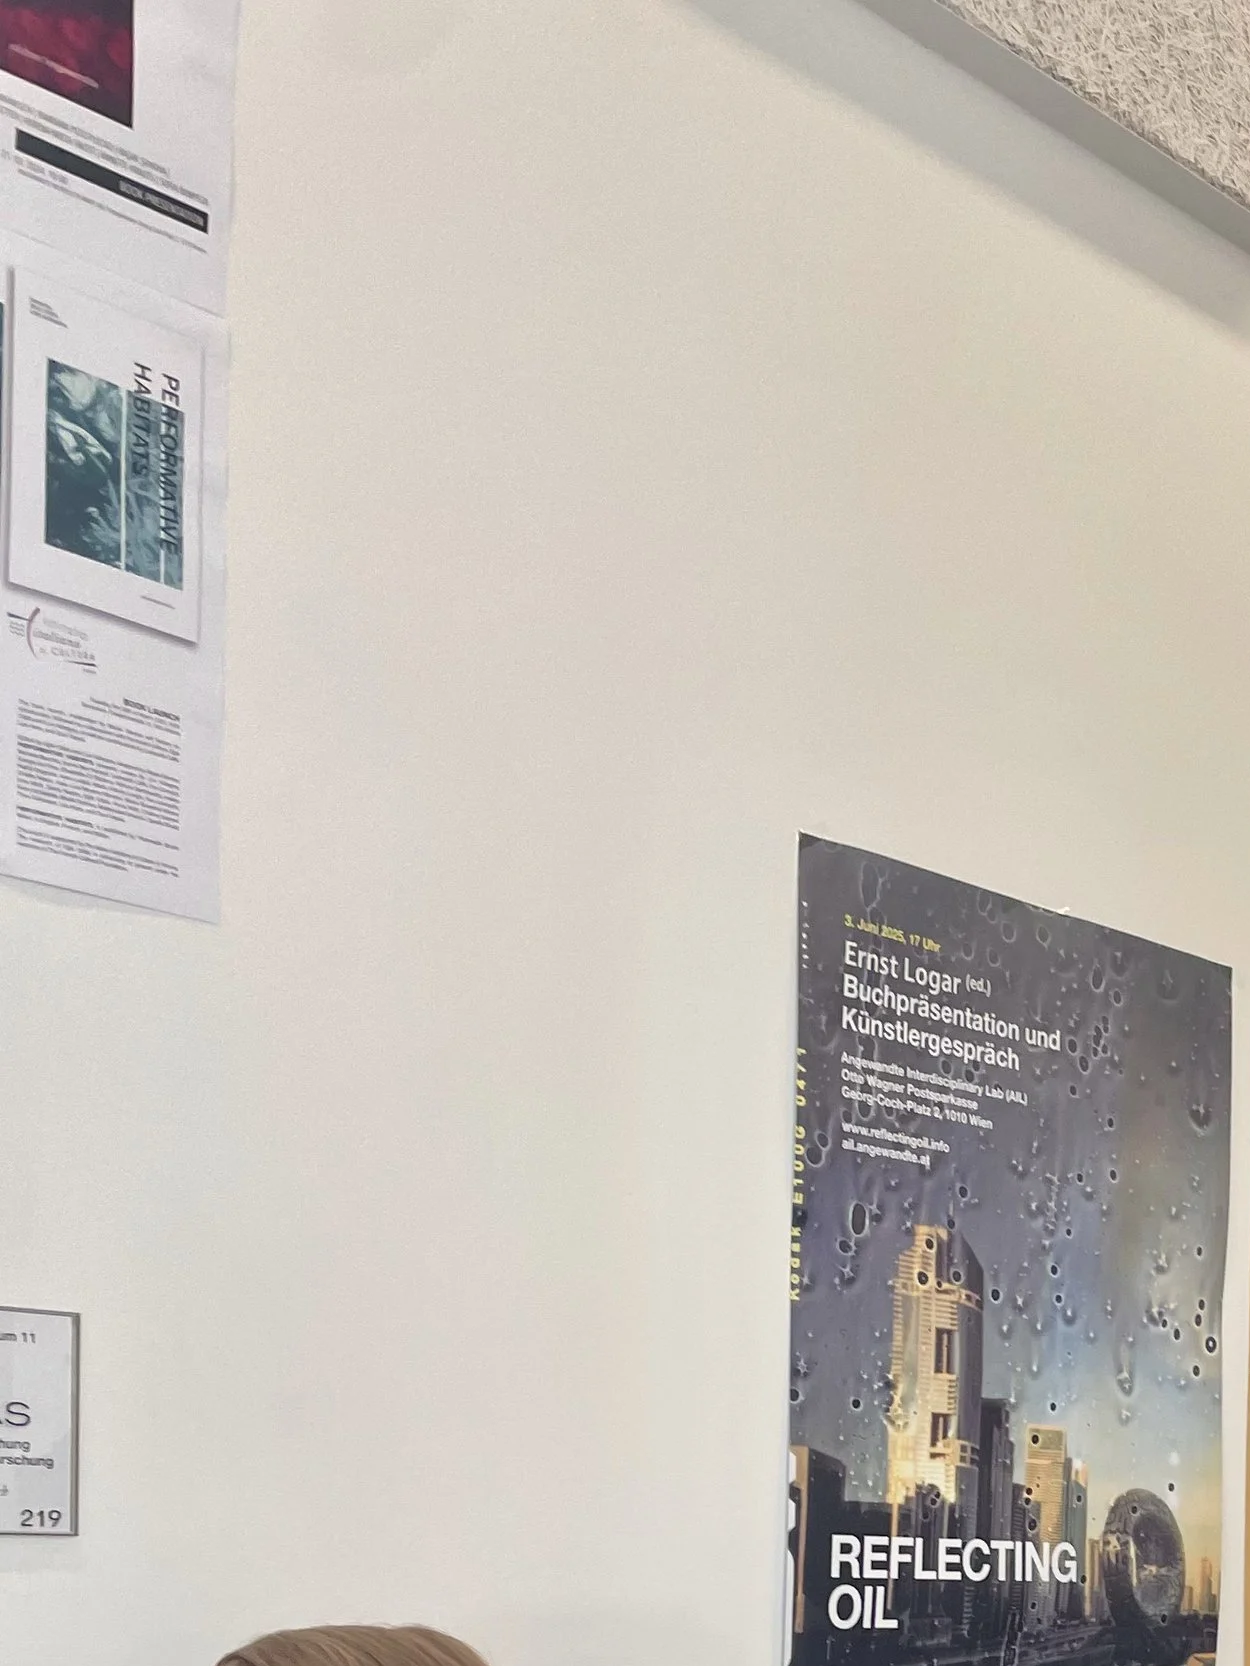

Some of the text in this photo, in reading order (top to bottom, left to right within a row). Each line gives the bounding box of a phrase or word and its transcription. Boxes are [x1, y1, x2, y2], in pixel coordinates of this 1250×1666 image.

[132, 361, 152, 477] HABITATS
[158, 373, 181, 555] PERFORMATIVE
[909, 934, 920, 947] 17
[922, 937, 941, 952] Uhr
[844, 940, 992, 998] Ernst Logar (ed.)
[843, 973, 1061, 1051] Buchpräsentation und
[842, 1005, 1021, 1071] Künstlergespräch
[841, 1051, 1028, 1106] Angewandte Interdisciplinary Lab (AIL)
[841, 1069, 978, 1110] Otto Wagner Postsparkasse
[841, 1086, 931, 1116] Georg-Coch-Platz
[945, 1108, 968, 1125] 1010
[969, 1113, 993, 1130] Wien
[841, 1122, 950, 1153] www.reflectingoil.info
[841, 1138, 930, 1166] ail.angewandte.at
[20, 1509, 62, 1527] 219
[830, 1533, 1078, 1583] REFLECTING
[827, 1584, 899, 1630] OIL
